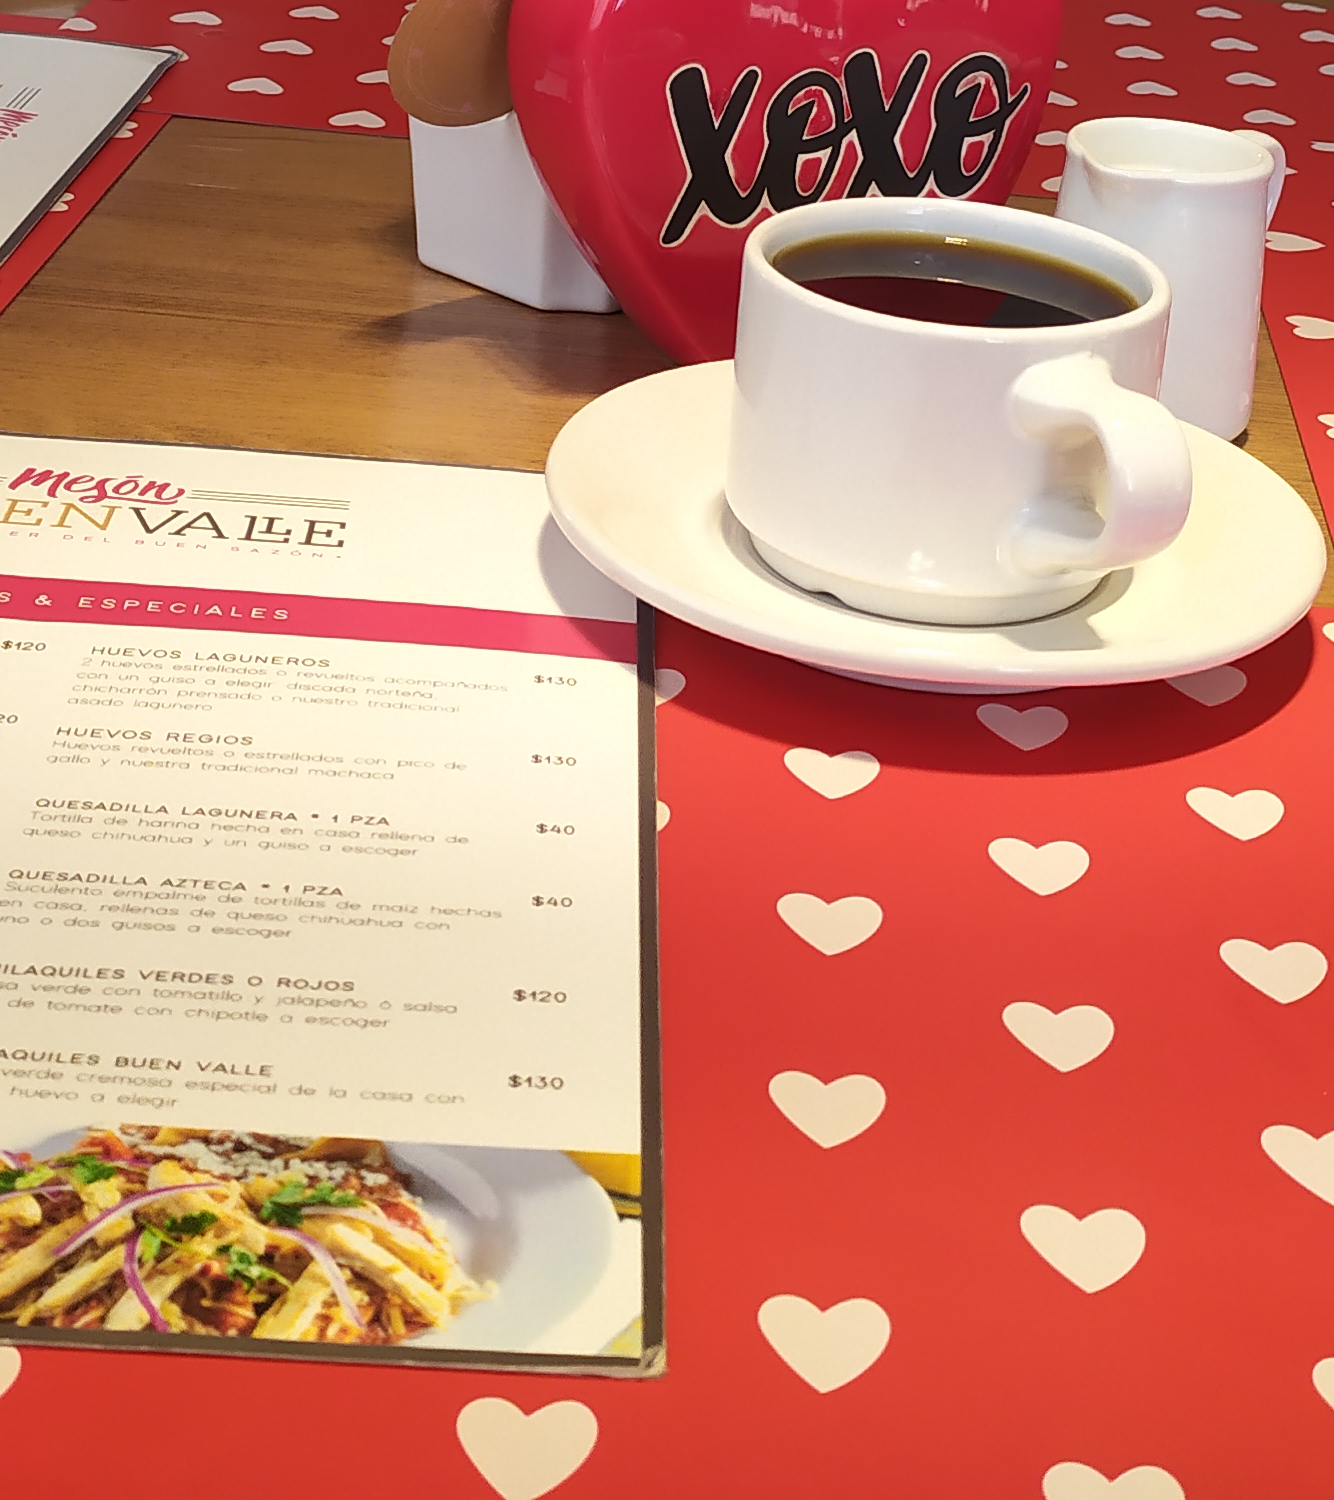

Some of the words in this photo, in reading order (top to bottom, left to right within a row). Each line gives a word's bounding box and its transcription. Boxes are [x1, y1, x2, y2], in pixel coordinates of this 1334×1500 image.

[62, 534, 112, 544] DEL
[134, 539, 208, 551] BUEN
[34, 594, 52, 606] &
[77, 596, 288, 620] ESPECIALES
[0, 640, 47, 651] $120
[91, 645, 182, 659] HUEVOS
[194, 651, 330, 668] LAGUNEROS
[533, 674, 577, 686] $130
[56, 726, 152, 740] HUEVOS
[165, 731, 253, 746] REGIOS
[531, 753, 577, 766] $130
[35, 797, 169, 814] QUESADILLA
[181, 806, 297, 821] LAGUNERA
[350, 814, 390, 826] PZA
[536, 822, 575, 835] $40
[8, 868, 148, 886] QUESADILLA
[159, 878, 247, 891] AZTECA
[302, 884, 343, 896] PZA
[531, 895, 573, 908] $40
[138, 969, 234, 986] VERDES
[246, 975, 263, 987] O
[276, 976, 354, 992] ROJOS
[30, 983, 92, 995] verde
[101, 986, 141, 996] con
[152, 988, 243, 1002] tomatillo
[253, 995, 264, 1006] y
[403, 1001, 458, 1014] salsa
[512, 988, 567, 1003] $120
[6, 996, 35, 1009] de
[46, 1000, 123, 1014] tomate
[133, 1006, 173, 1016] con
[184, 1007, 269, 1023] chipotle
[279, 1014, 293, 1024] a
[304, 1015, 390, 1030] escoger
[114, 1055, 182, 1071] BUEN
[196, 1060, 273, 1077] VALLE
[507, 1073, 564, 1089] $130
